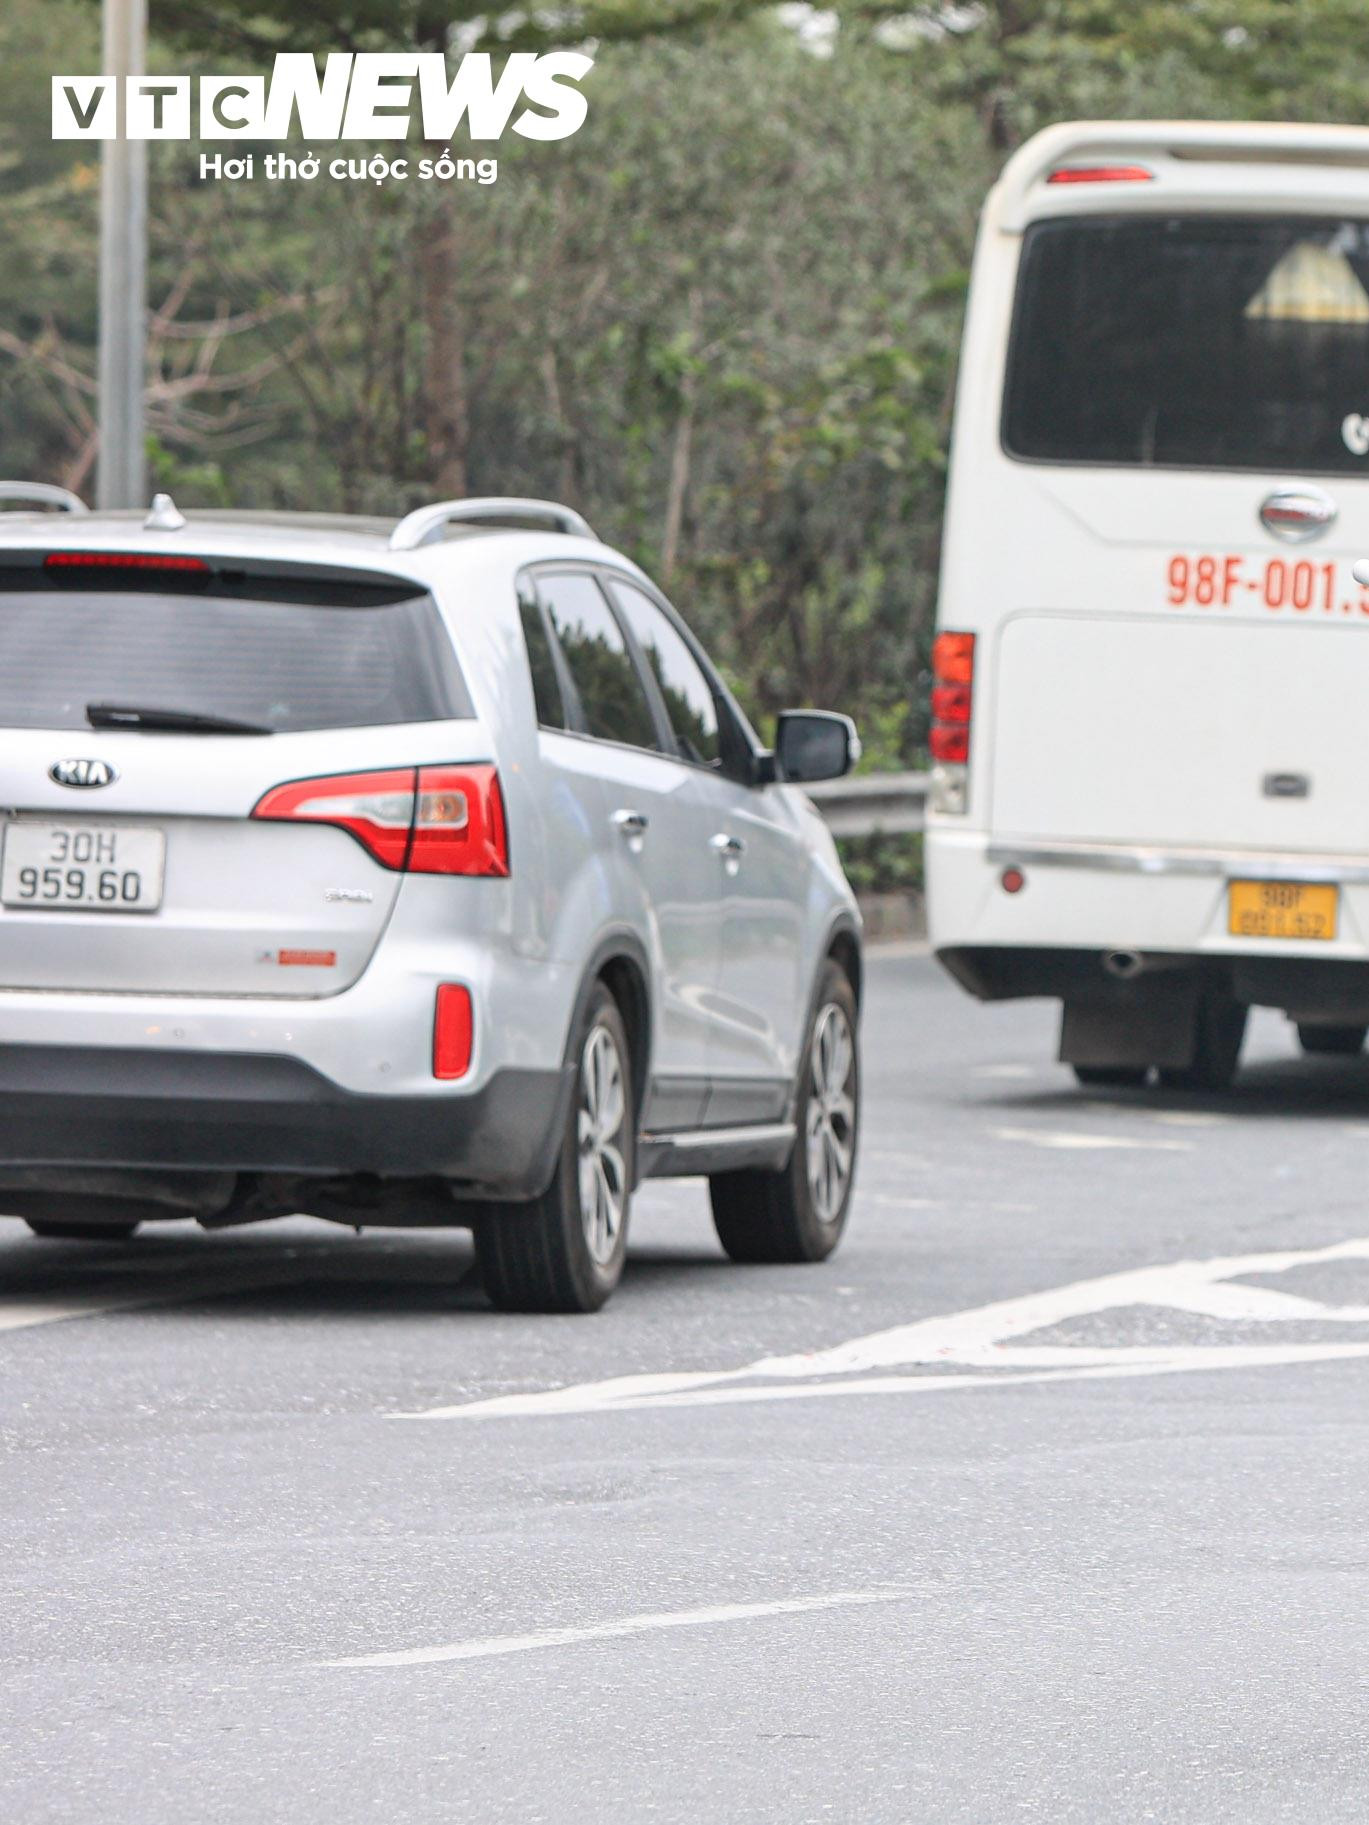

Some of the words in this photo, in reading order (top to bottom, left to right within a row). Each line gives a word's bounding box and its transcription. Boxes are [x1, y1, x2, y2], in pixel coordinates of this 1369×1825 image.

[57, 760, 109, 785] KIA
[50, 831, 116, 863] 30H
[19, 866, 141, 902] 959.60
